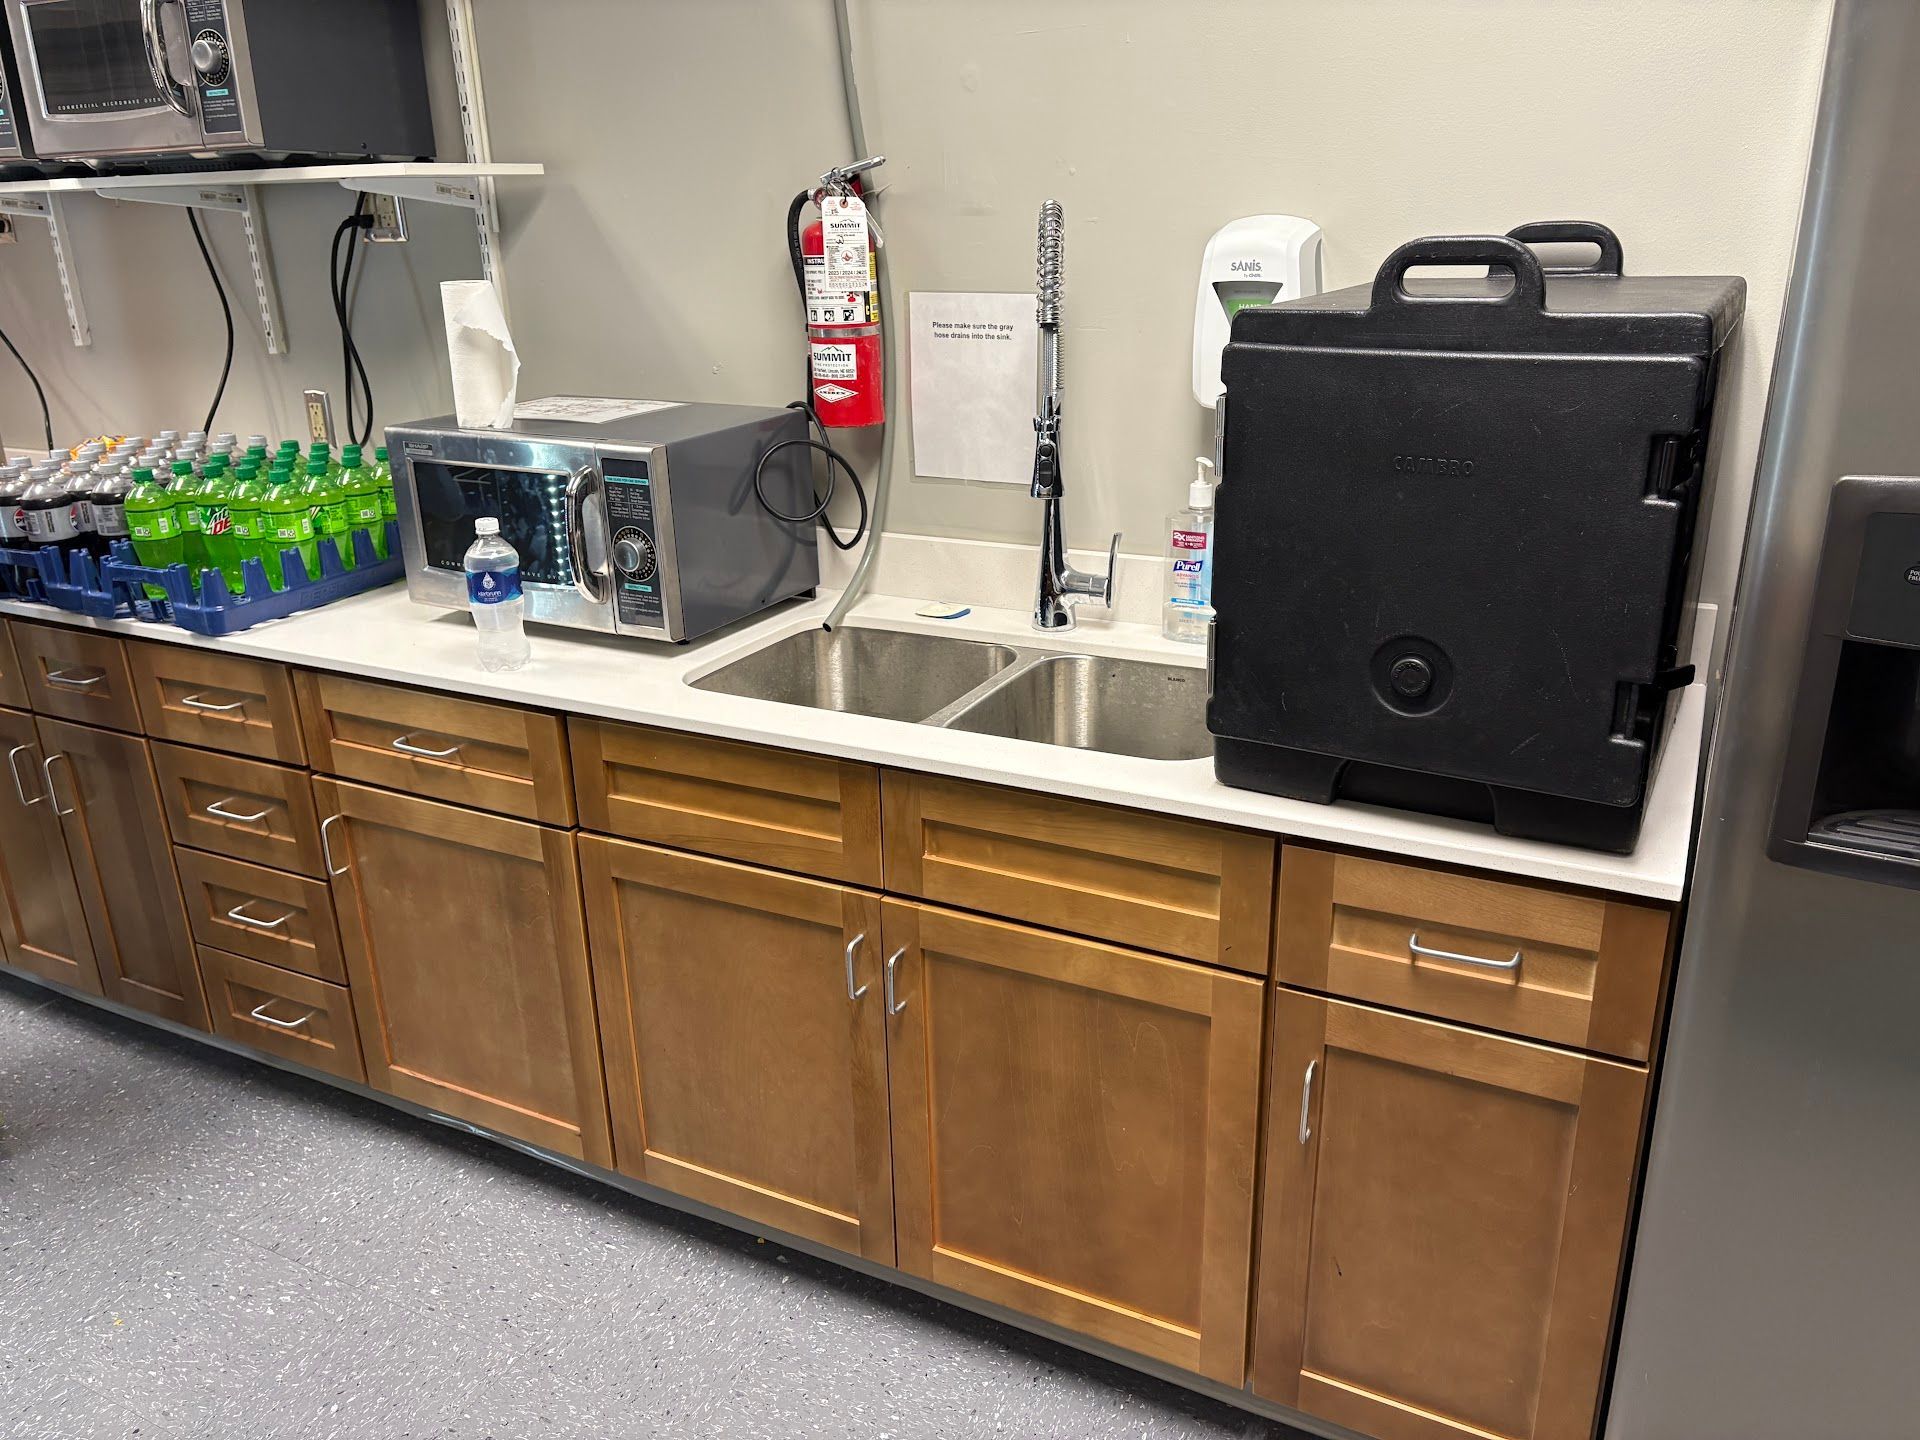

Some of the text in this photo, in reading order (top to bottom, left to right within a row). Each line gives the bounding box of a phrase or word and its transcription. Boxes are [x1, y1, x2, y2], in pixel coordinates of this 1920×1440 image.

[57, 102, 99, 111] COMMERCIAL
[102, 98, 140, 107] MICROWAVE
[932, 321, 953, 329] Please
[971, 332, 984, 340] into
[996, 333, 1012, 341] sink.
[813, 352, 852, 362] SUMMIT
[1393, 456, 1474, 476] CAMBRO
[1174, 532, 1185, 541] 2X
[1176, 560, 1201, 572] Purell
